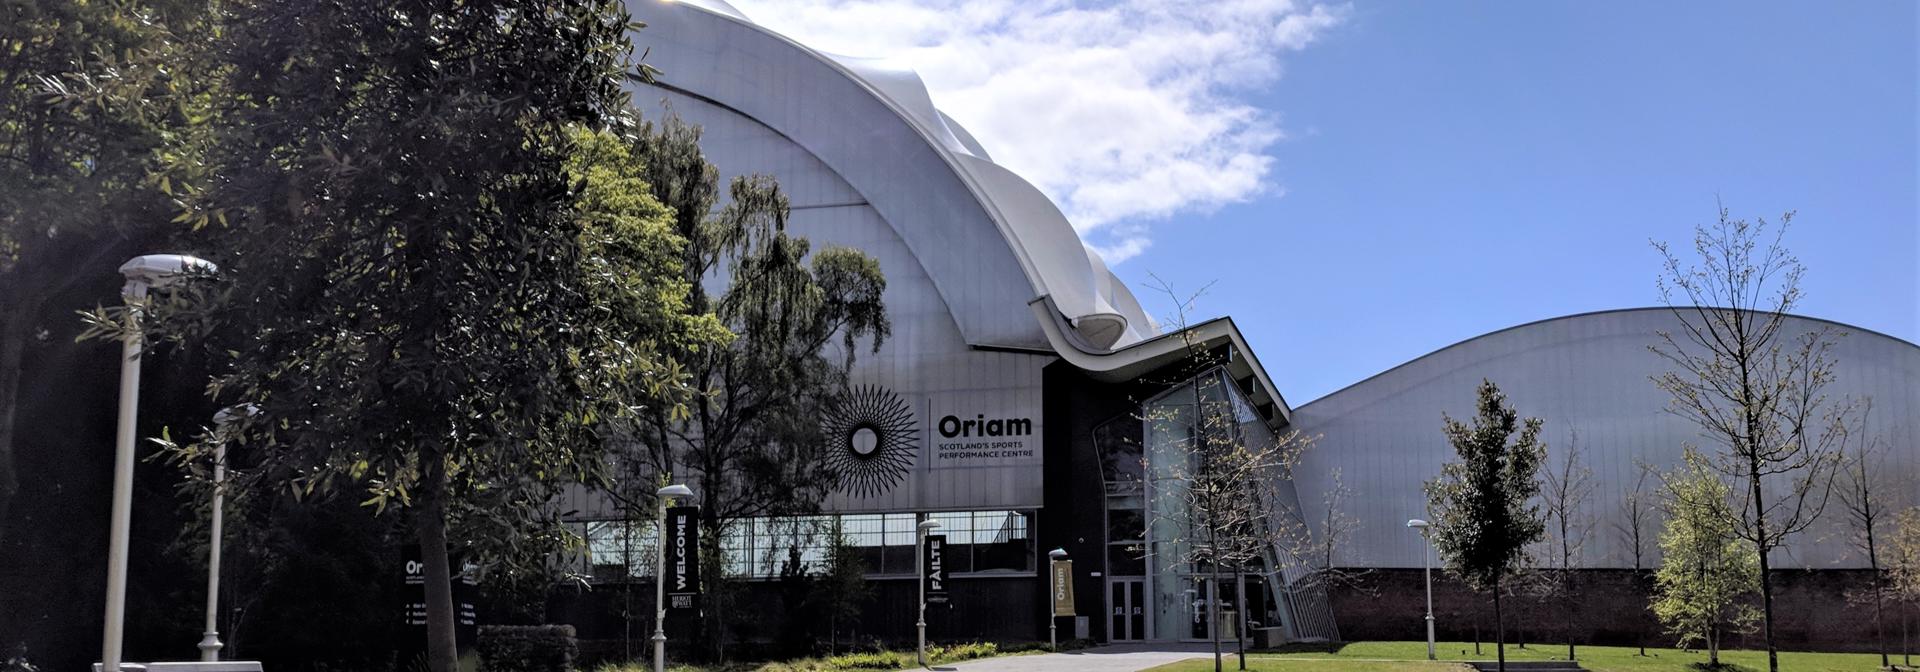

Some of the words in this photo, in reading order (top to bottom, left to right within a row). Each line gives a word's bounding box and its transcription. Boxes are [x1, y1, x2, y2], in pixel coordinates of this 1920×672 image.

[938, 414, 1032, 438] Oriam
[939, 442, 989, 450] SCOTLAND'S
[991, 441, 1023, 449] SPORTS
[939, 450, 999, 459] PERFORMANCE
[677, 515, 686, 590] WELCOME
[1057, 567, 1065, 601] Oriam
